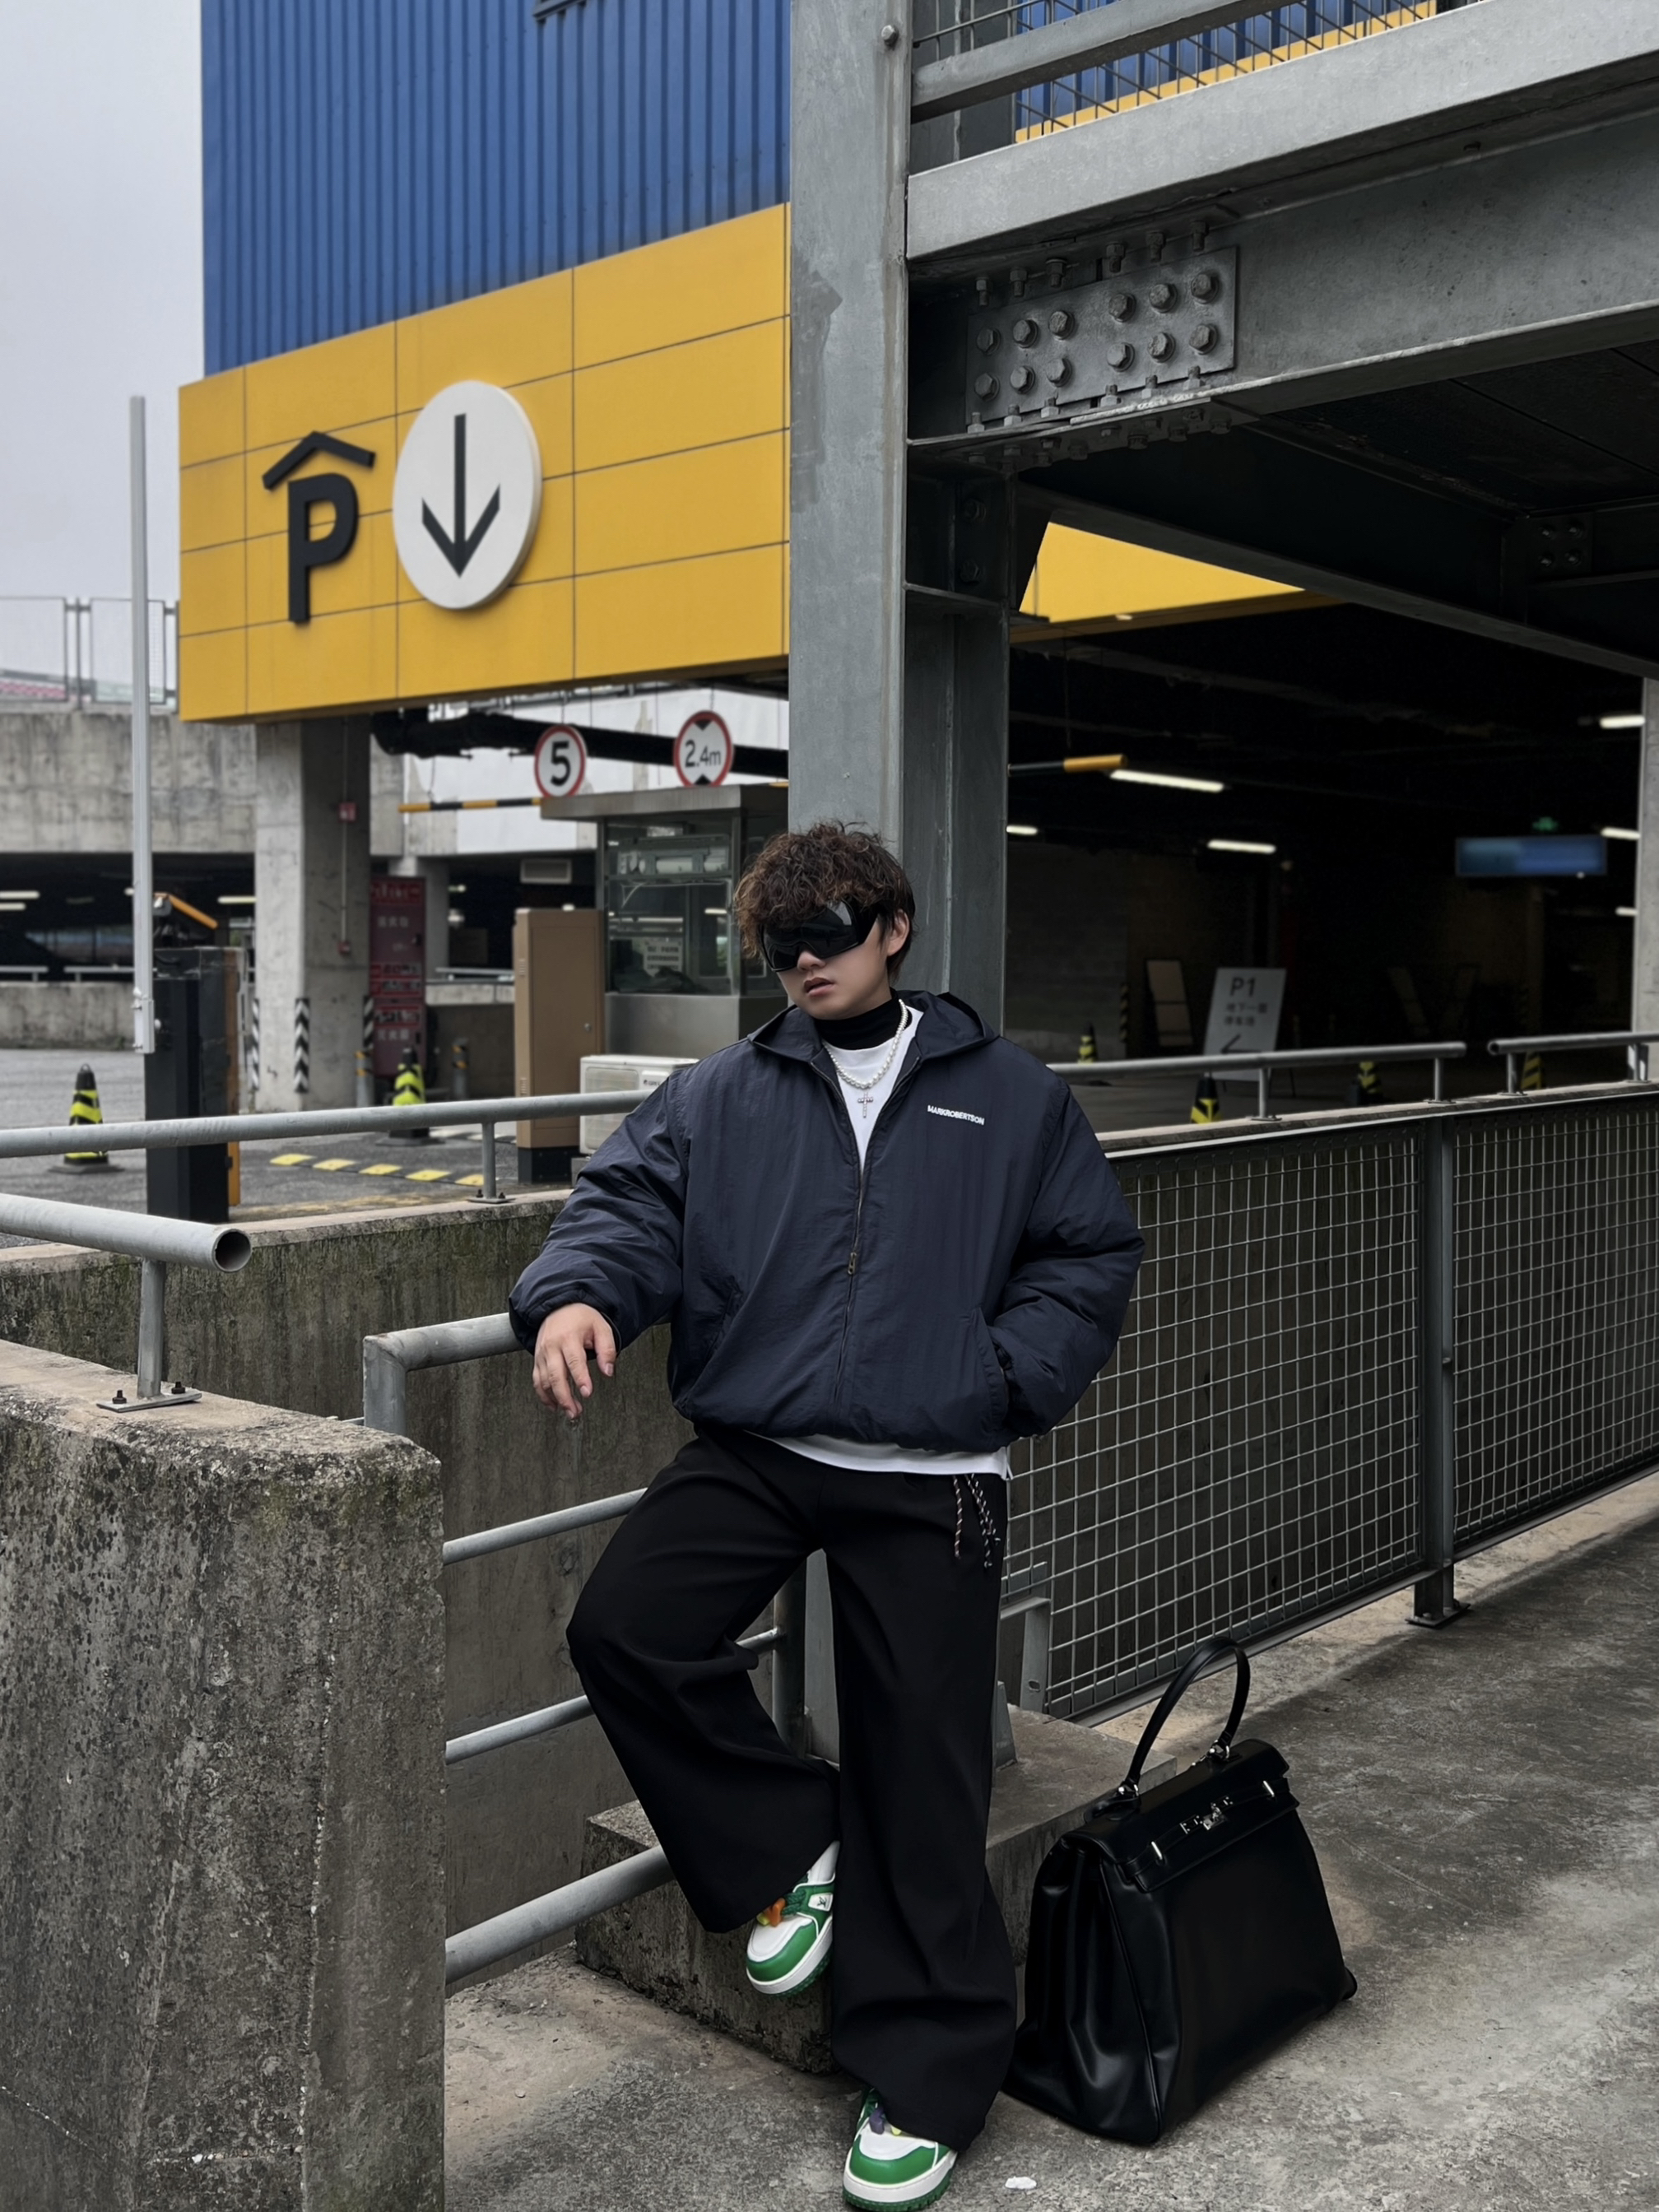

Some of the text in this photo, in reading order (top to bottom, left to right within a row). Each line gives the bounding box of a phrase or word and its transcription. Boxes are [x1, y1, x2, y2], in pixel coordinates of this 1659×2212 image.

[288, 472, 360, 625] P
[551, 741, 571, 787] 5
[685, 740, 722, 768] 2.4m
[1229, 976, 1257, 997] P1
[927, 1104, 985, 1126] MARKROBERTSON
